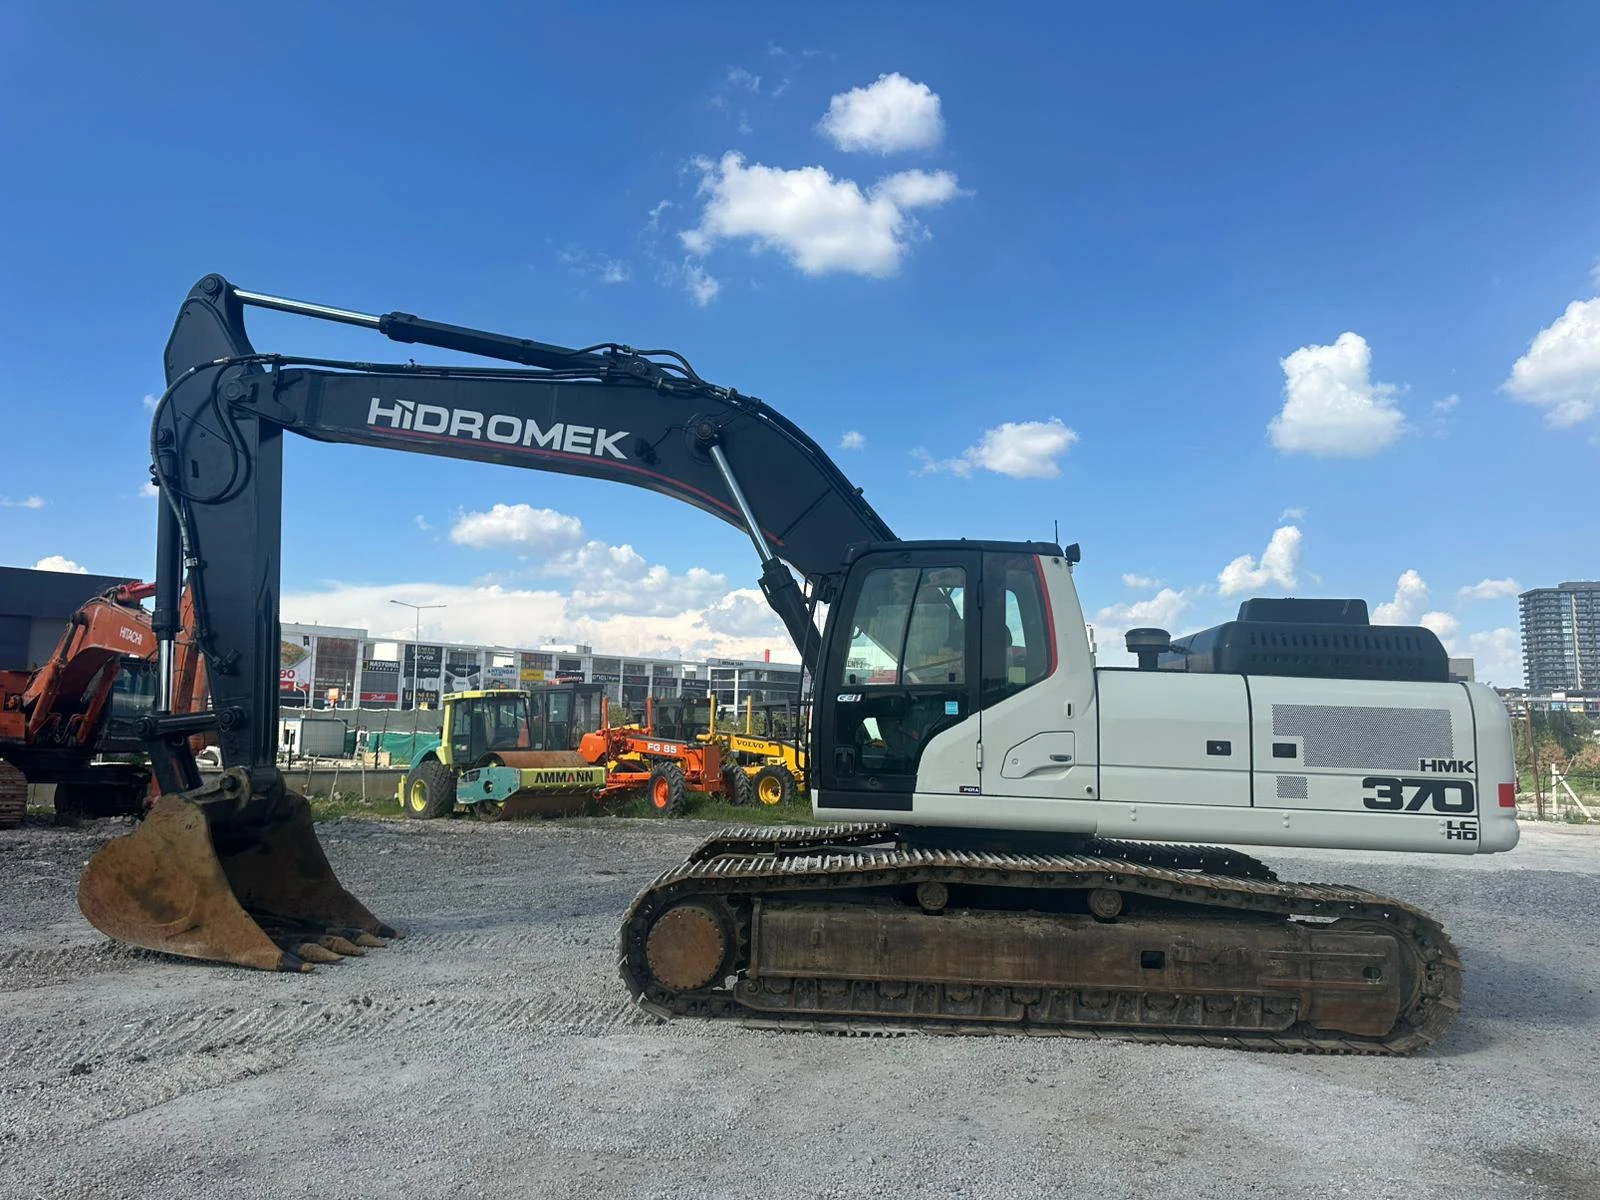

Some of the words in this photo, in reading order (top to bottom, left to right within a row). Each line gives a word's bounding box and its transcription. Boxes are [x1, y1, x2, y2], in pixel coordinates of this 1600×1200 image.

[120, 626, 143, 645] HITACHI
[647, 743, 661, 752] FG
[663, 744, 677, 754] 85
[736, 739, 764, 749] VOLVO
[1420, 759, 1474, 773] HMK
[534, 772, 594, 784] AMMANN
[1362, 777, 1475, 813] 370
[1447, 820, 1477, 831] LC
[1447, 830, 1477, 841] HD
